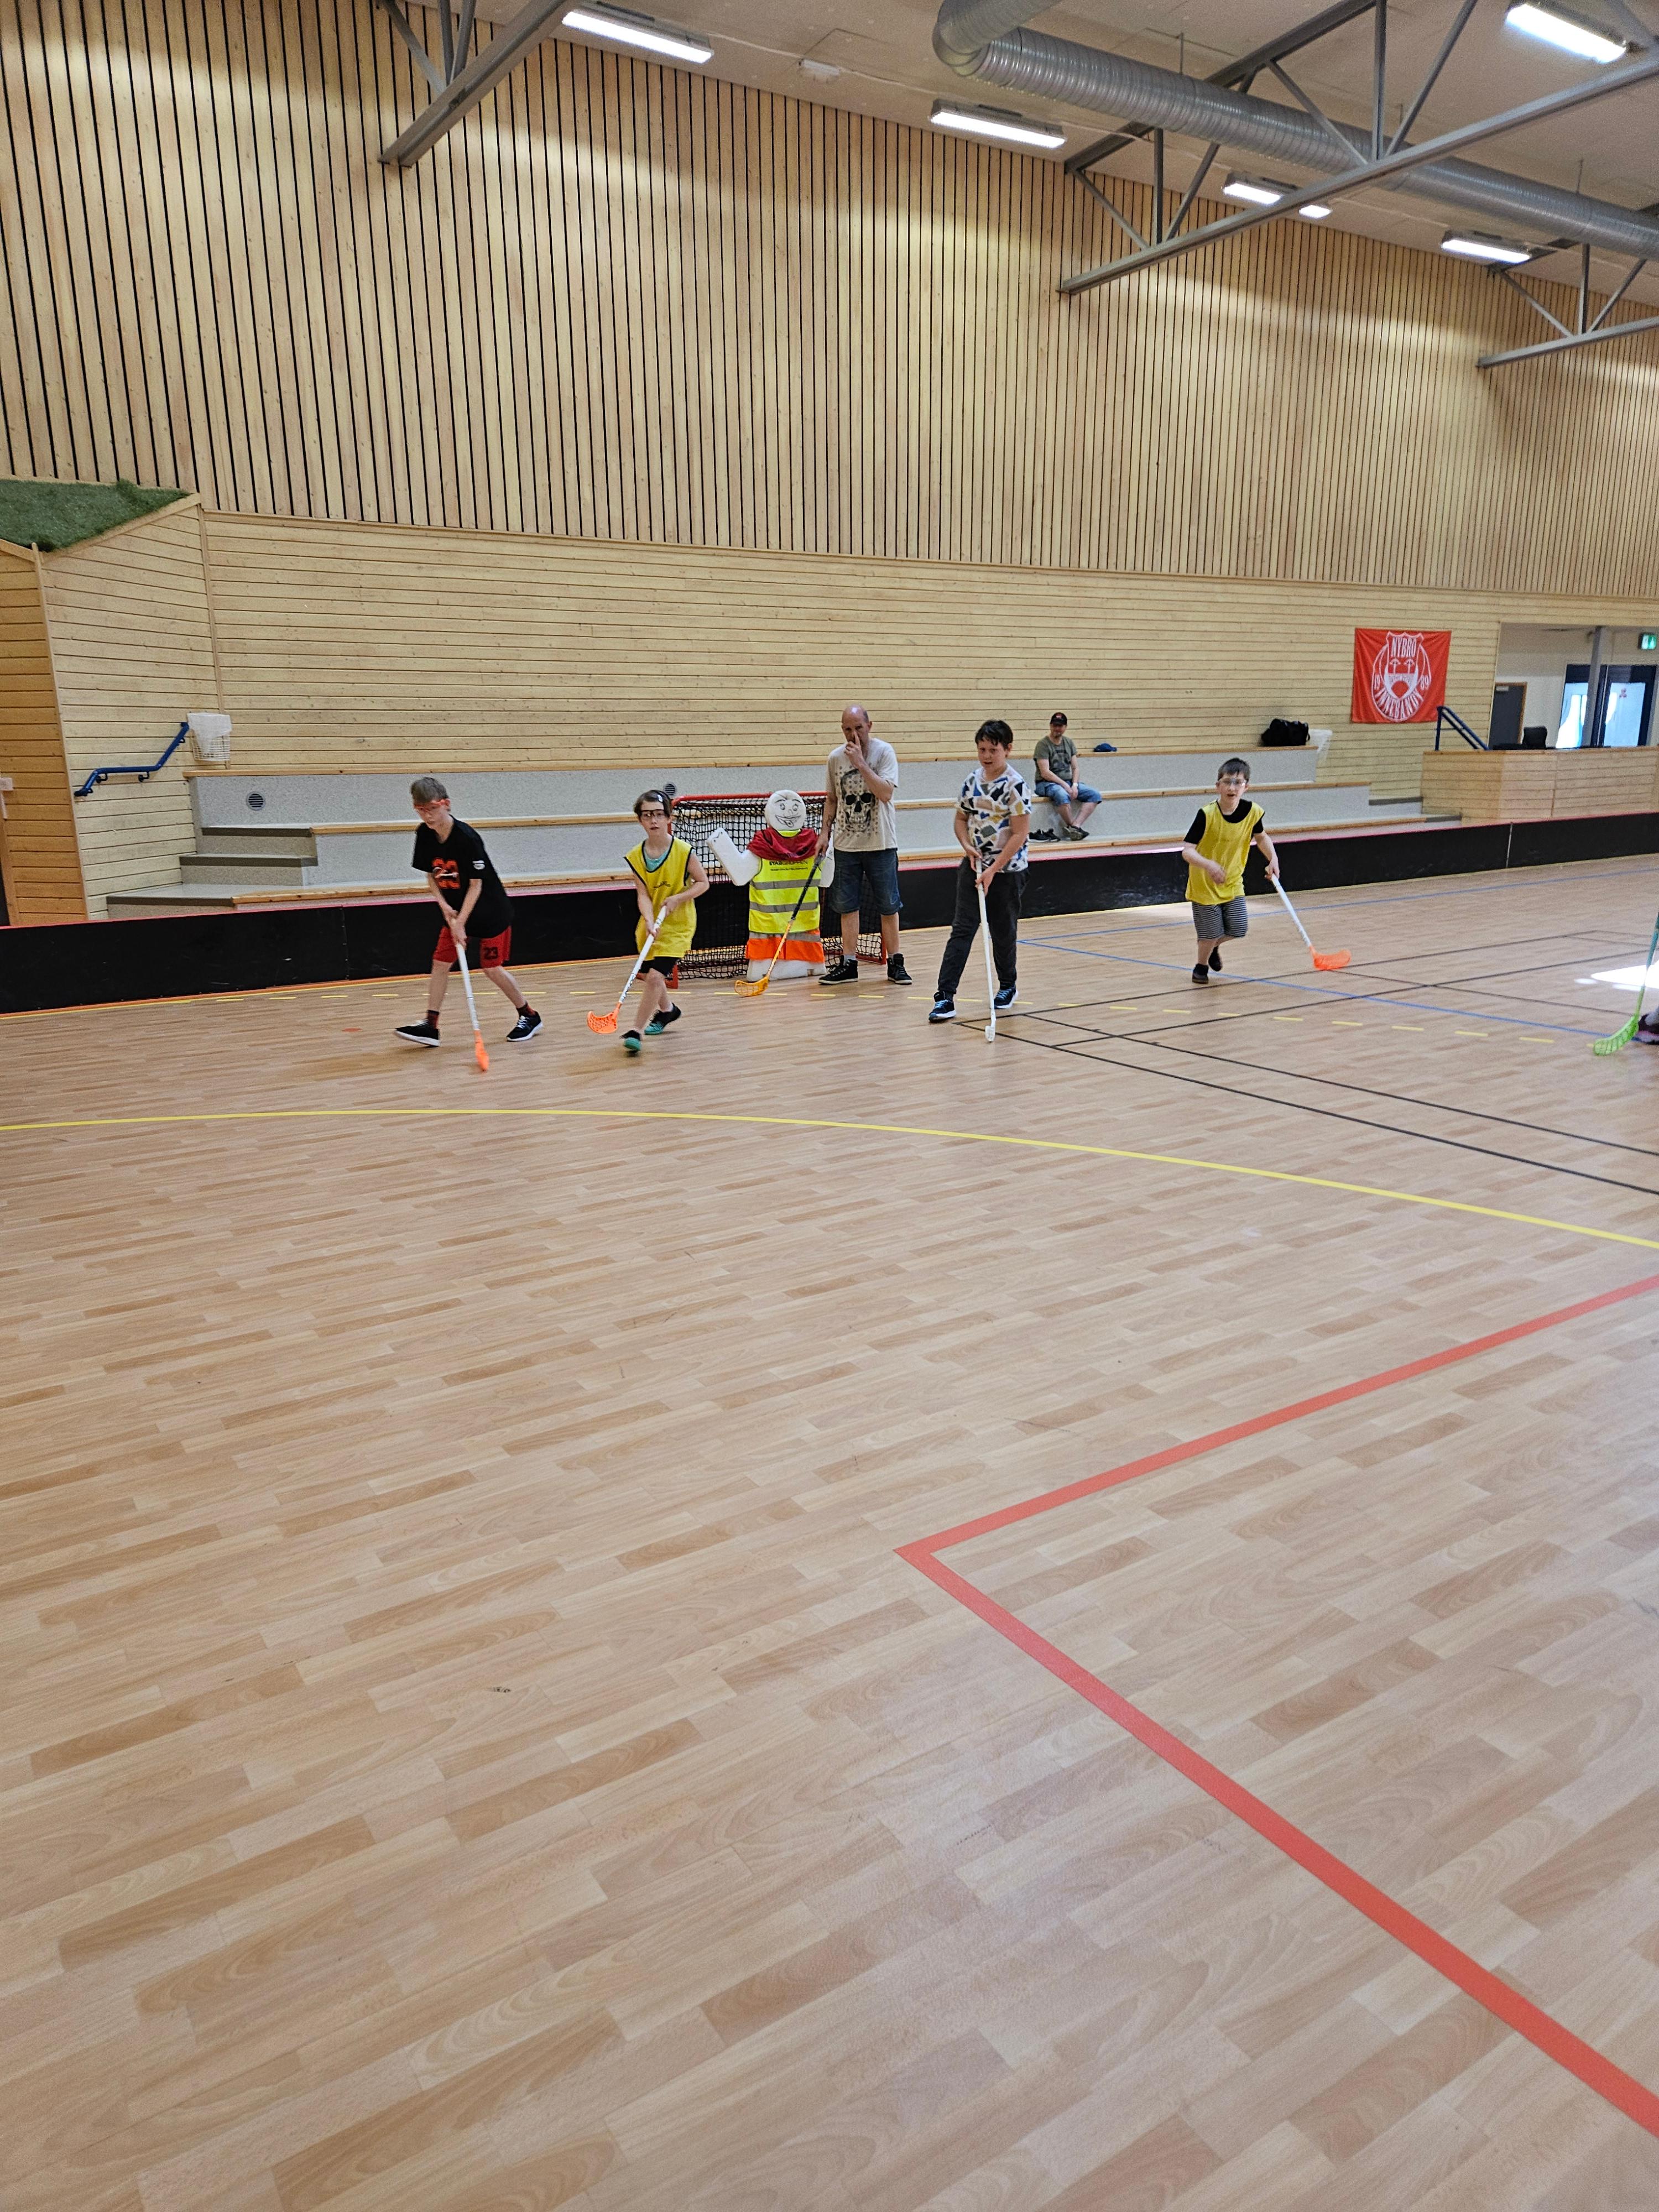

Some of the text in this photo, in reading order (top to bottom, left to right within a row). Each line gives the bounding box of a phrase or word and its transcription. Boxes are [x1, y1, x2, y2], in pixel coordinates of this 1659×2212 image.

[1391, 637, 1417, 657] NYBRO
[1374, 674, 1380, 690] 19
[1420, 675, 1429, 690] 89
